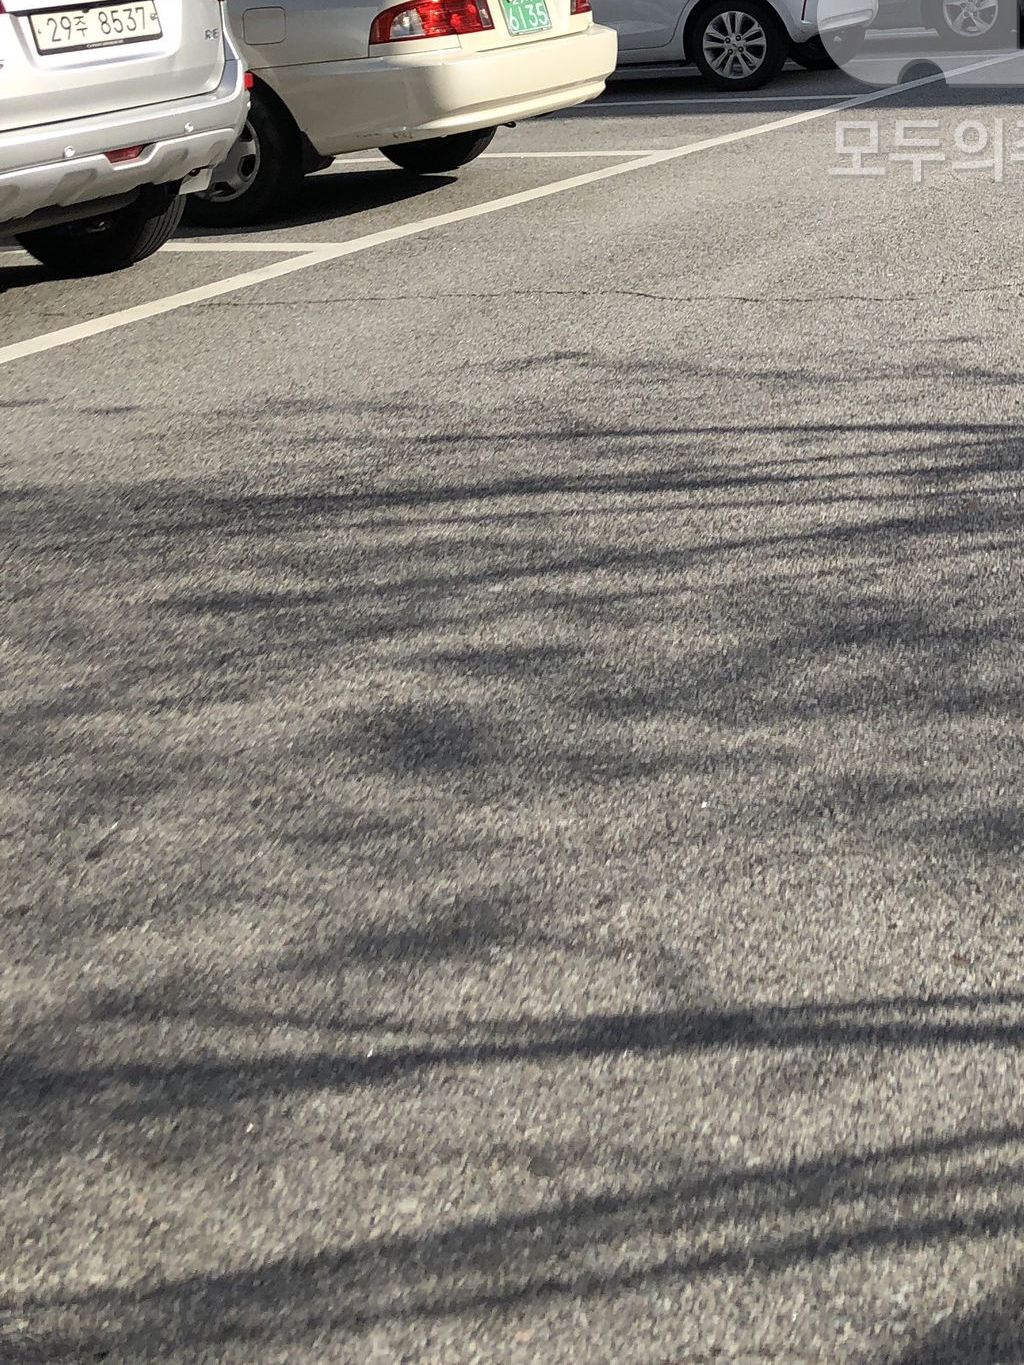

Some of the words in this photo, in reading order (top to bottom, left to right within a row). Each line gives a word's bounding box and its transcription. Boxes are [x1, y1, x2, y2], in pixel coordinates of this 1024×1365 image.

[46, 15, 89, 43] 29주
[98, 6, 146, 35] 8537
[508, 2, 548, 31] 6135
